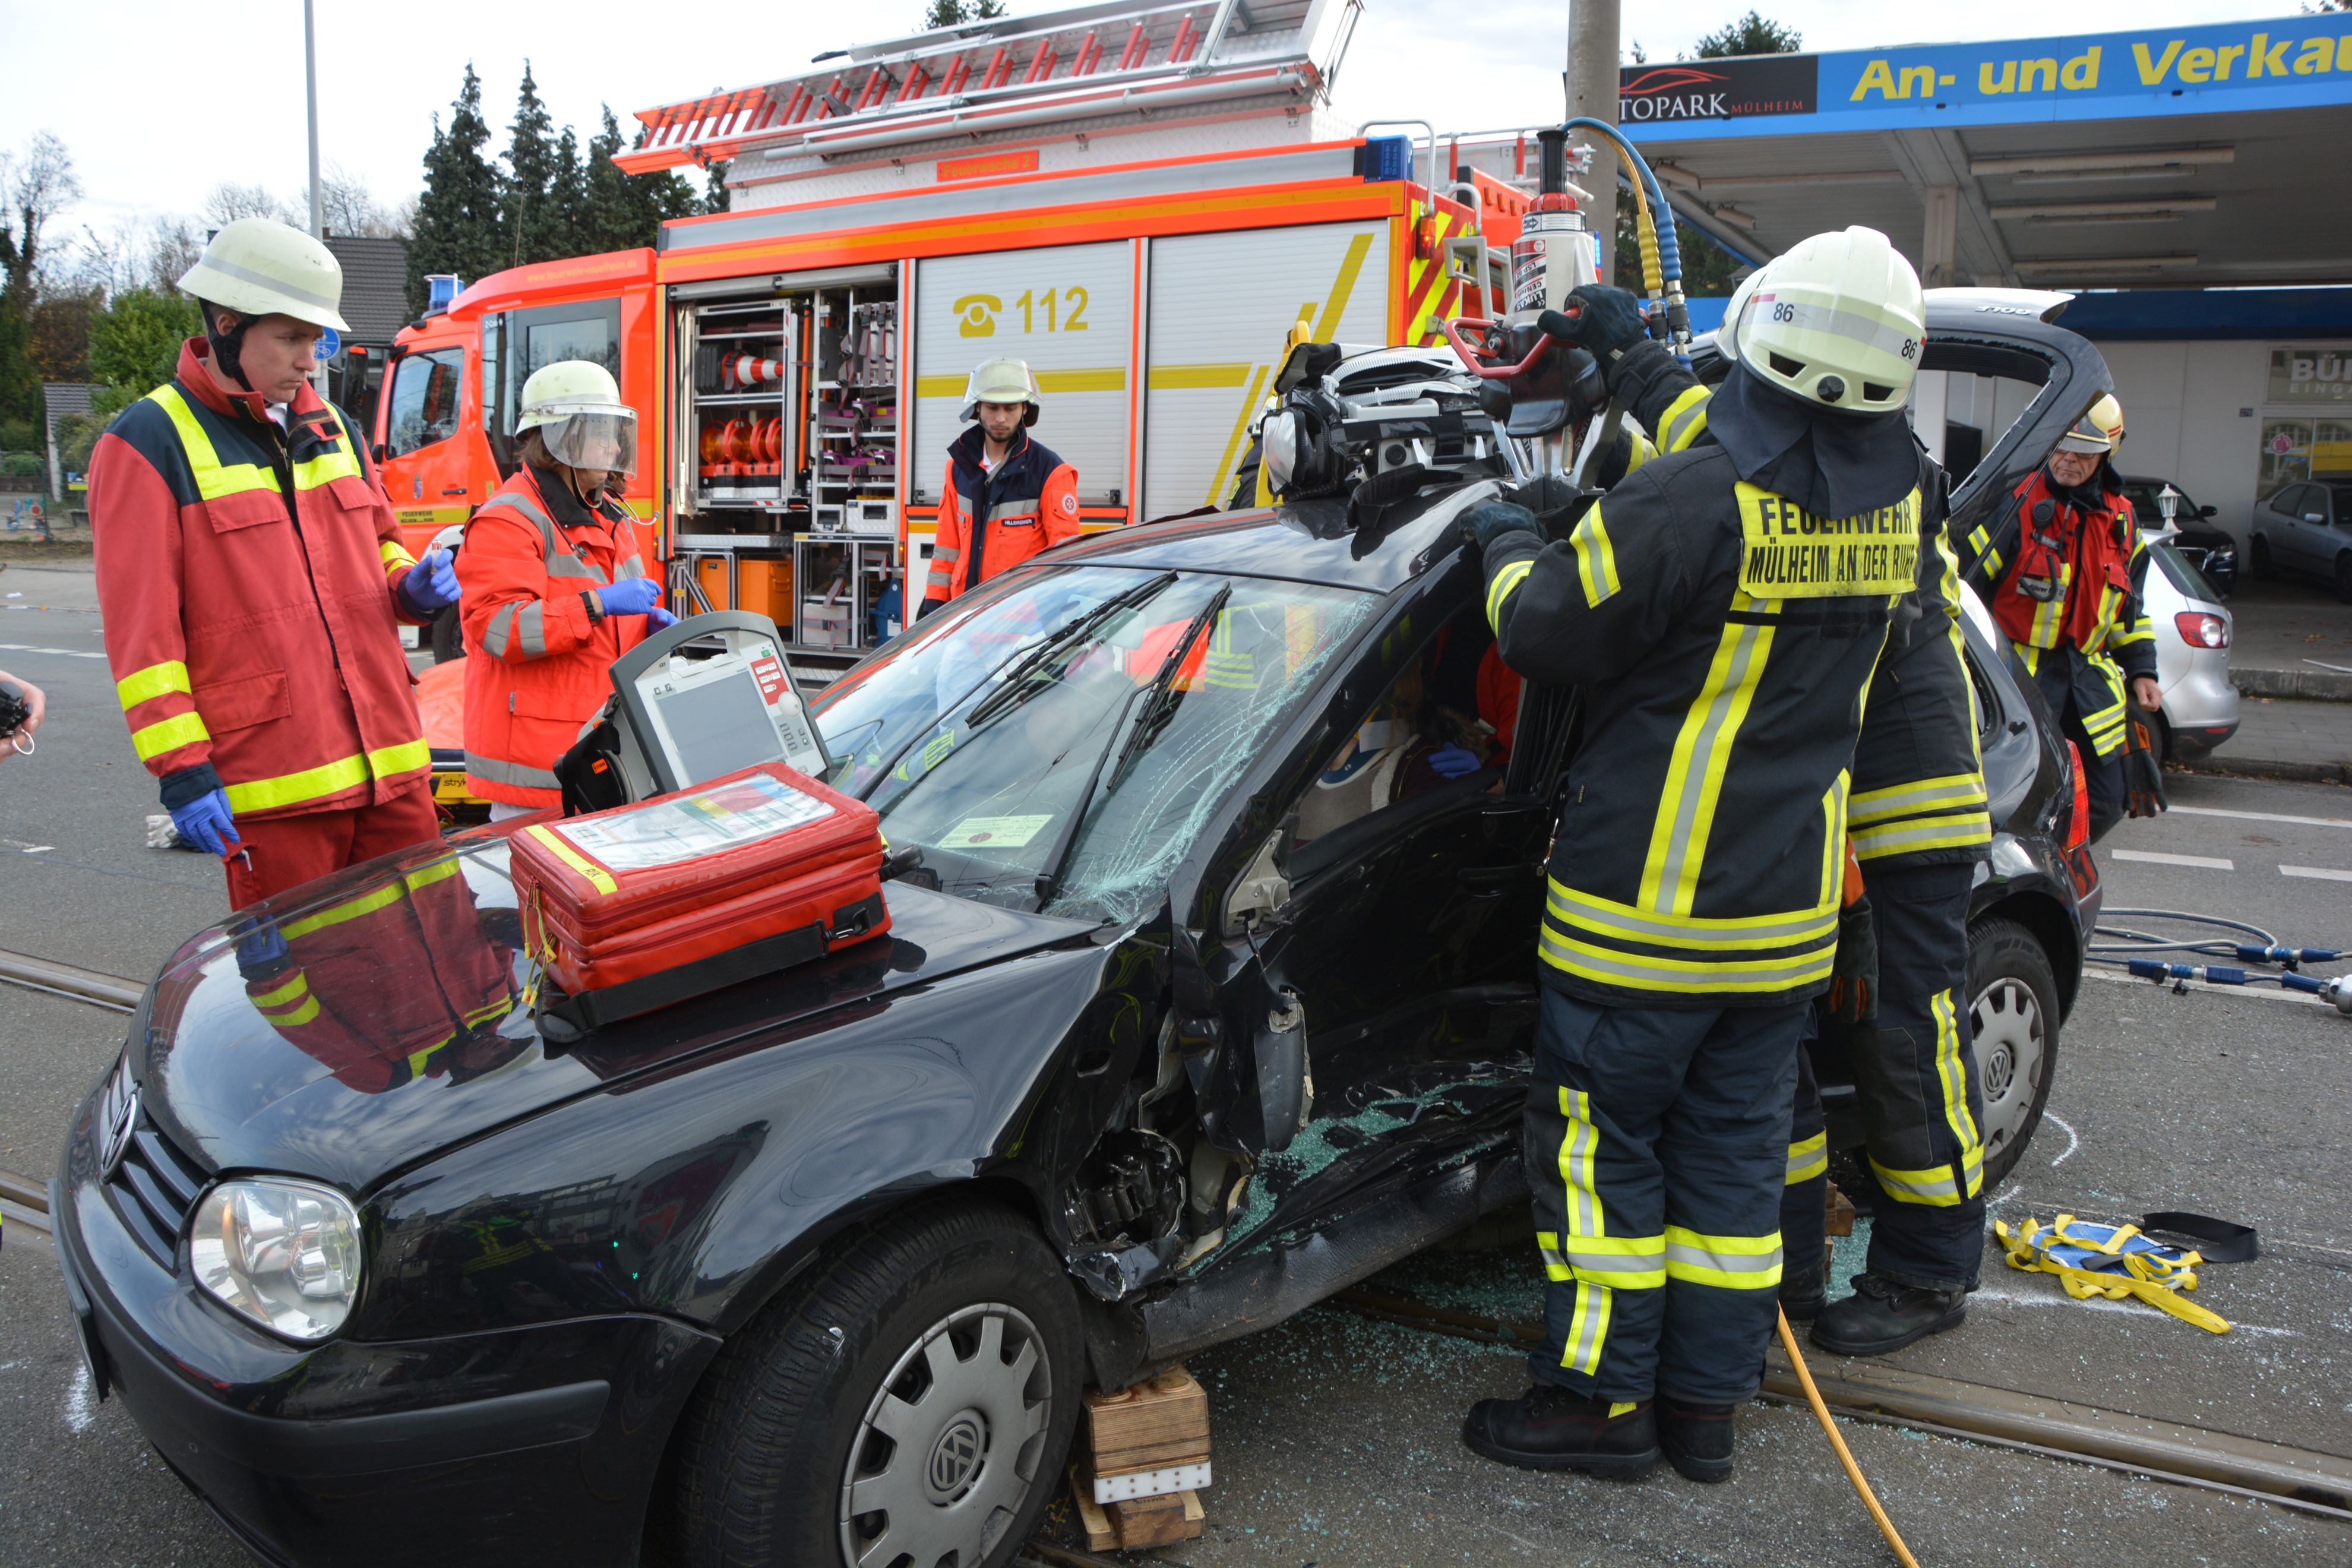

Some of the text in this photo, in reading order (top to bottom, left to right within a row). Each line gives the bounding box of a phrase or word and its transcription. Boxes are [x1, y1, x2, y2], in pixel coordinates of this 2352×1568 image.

[1849, 59, 1956, 102] An-
[1977, 46, 2102, 95] und
[1731, 100, 1804, 114] MÜLHEIM
[943, 154, 1030, 178] Feuerwache 2
[1523, 262, 1537, 273] LSP
[1016, 285, 1089, 334] 112
[1516, 289, 1544, 311] LUKAS
[1974, 305, 2032, 316] GOLF
[1773, 302, 1795, 323] 86
[1901, 338, 1918, 360] 86
[1746, 536, 1830, 584] MÜLHEIM
[1836, 544, 1858, 582] AN
[1863, 543, 1888, 581] DER
